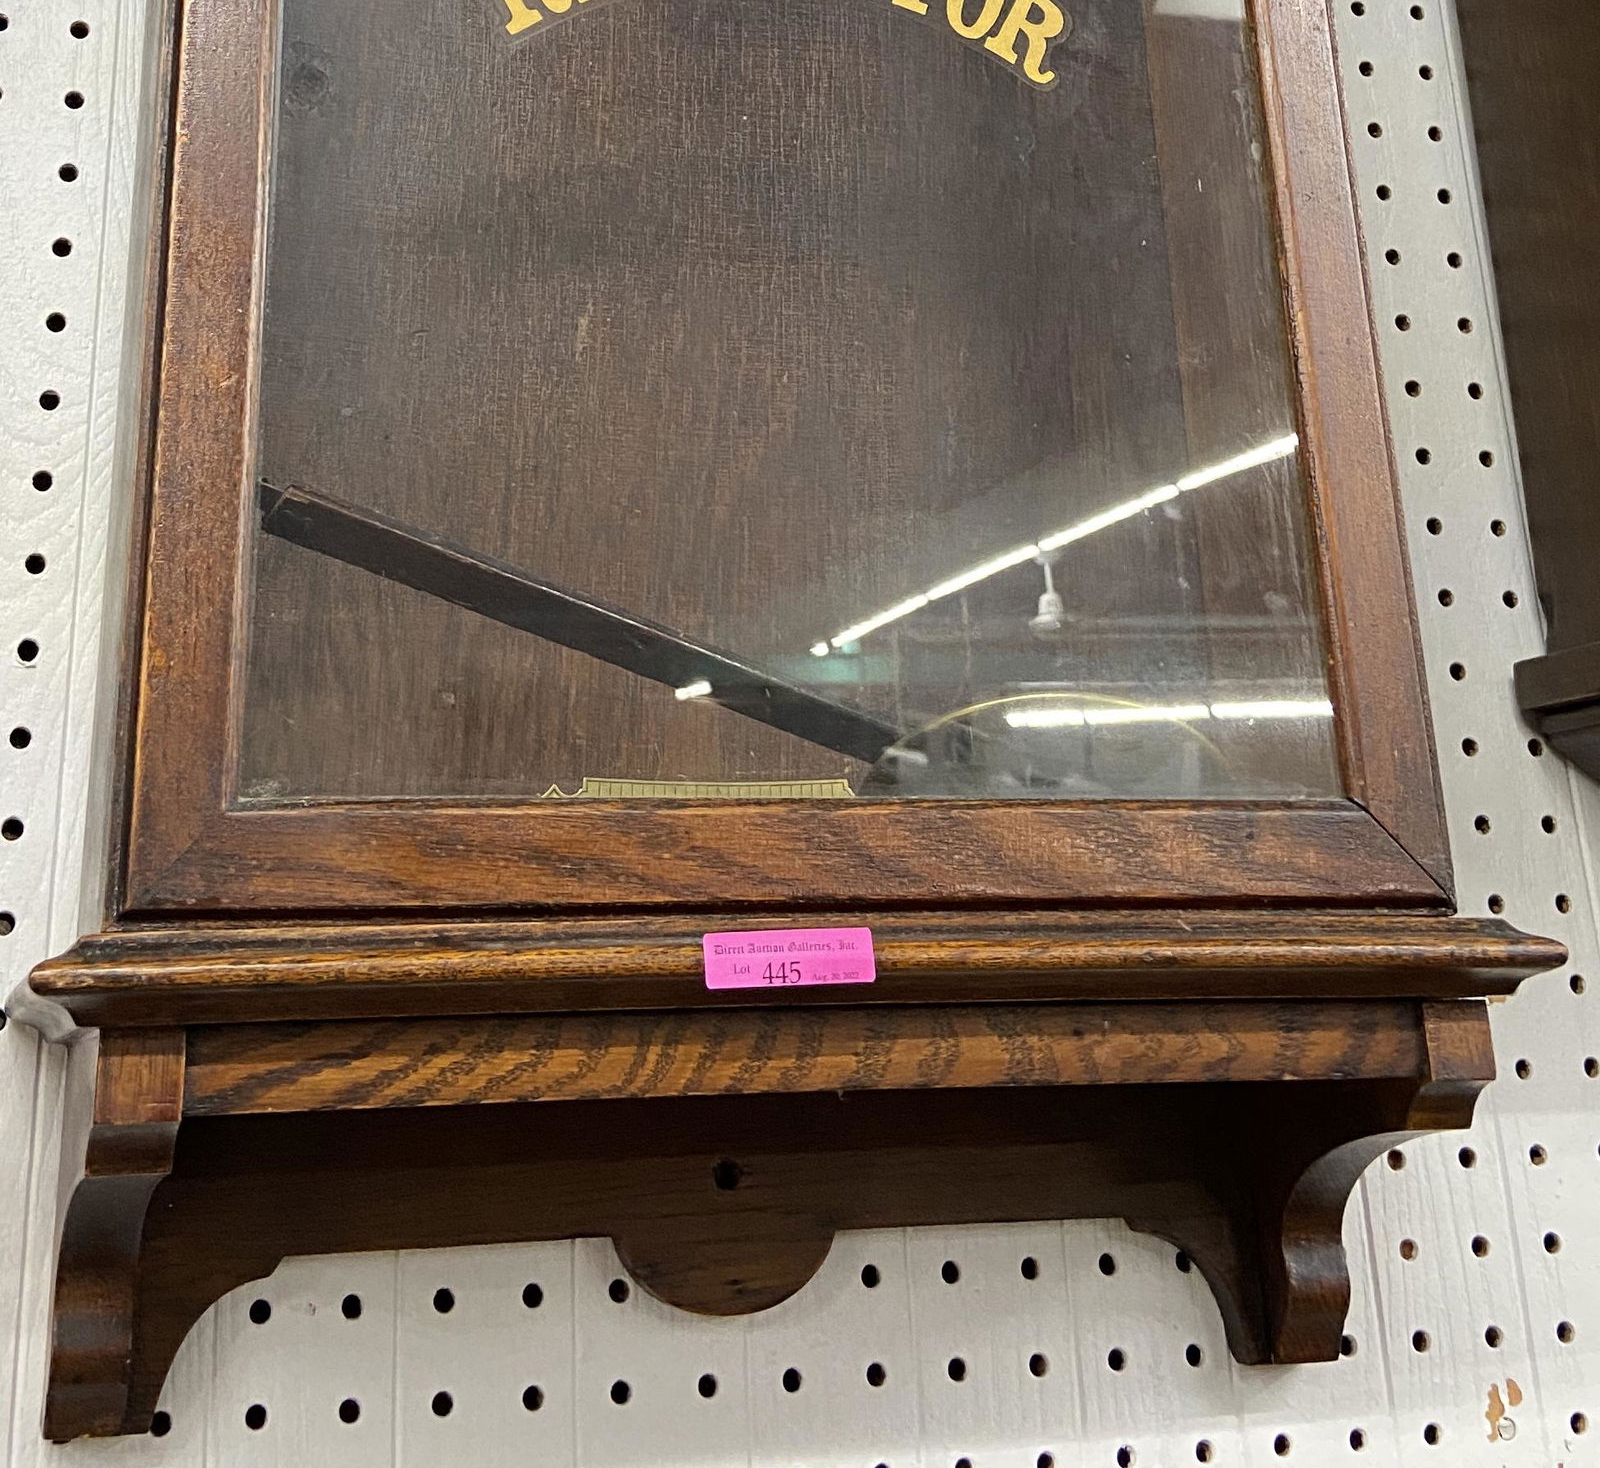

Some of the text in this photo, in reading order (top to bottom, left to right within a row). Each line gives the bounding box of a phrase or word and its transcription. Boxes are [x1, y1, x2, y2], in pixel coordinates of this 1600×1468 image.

[713, 944, 745, 956] Direct
[748, 943, 785, 954] Auction
[788, 941, 836, 952] Galleries,
[733, 961, 802, 984] Lot 445
